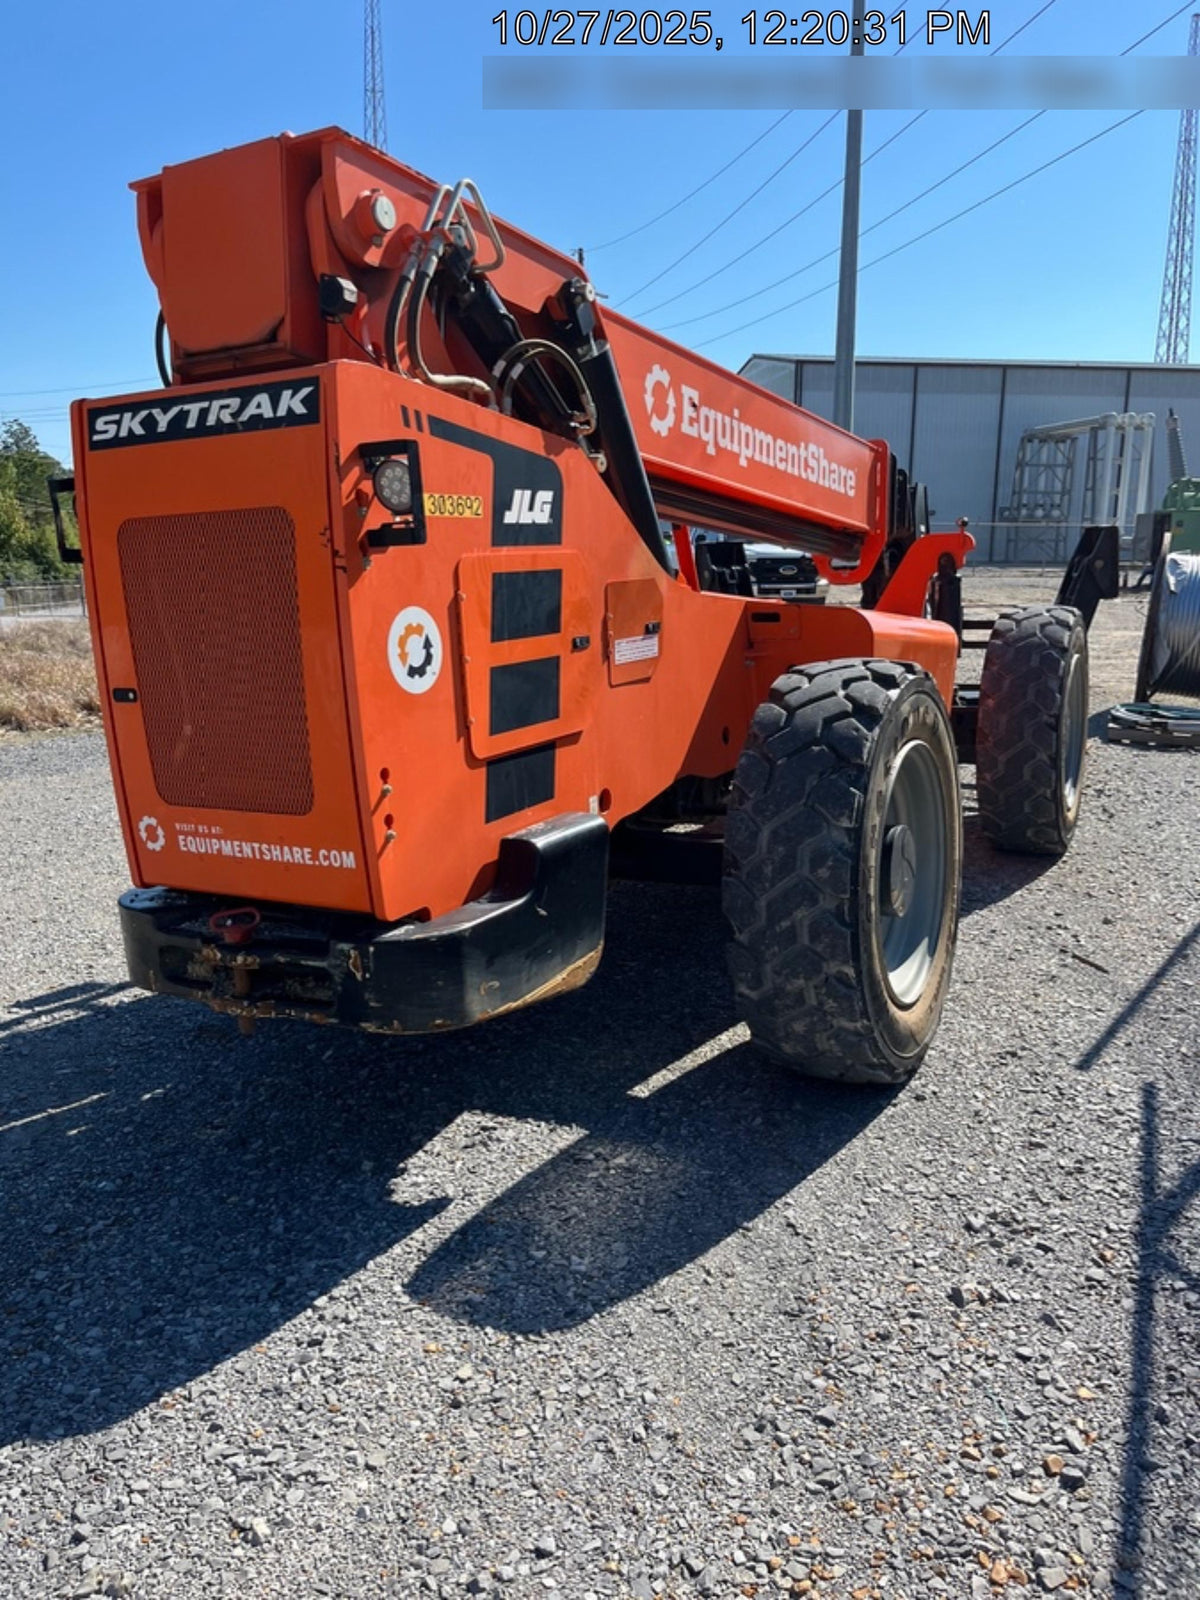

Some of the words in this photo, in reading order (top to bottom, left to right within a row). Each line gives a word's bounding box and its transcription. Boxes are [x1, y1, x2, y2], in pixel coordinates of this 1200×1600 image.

[92, 386, 315, 441] SKYTRAK
[681, 384, 856, 497] EquipmentShare
[428, 494, 482, 516] 303692
[503, 489, 554, 524] JLG
[178, 835, 356, 869] EQUIPMENTSHARE.COM
